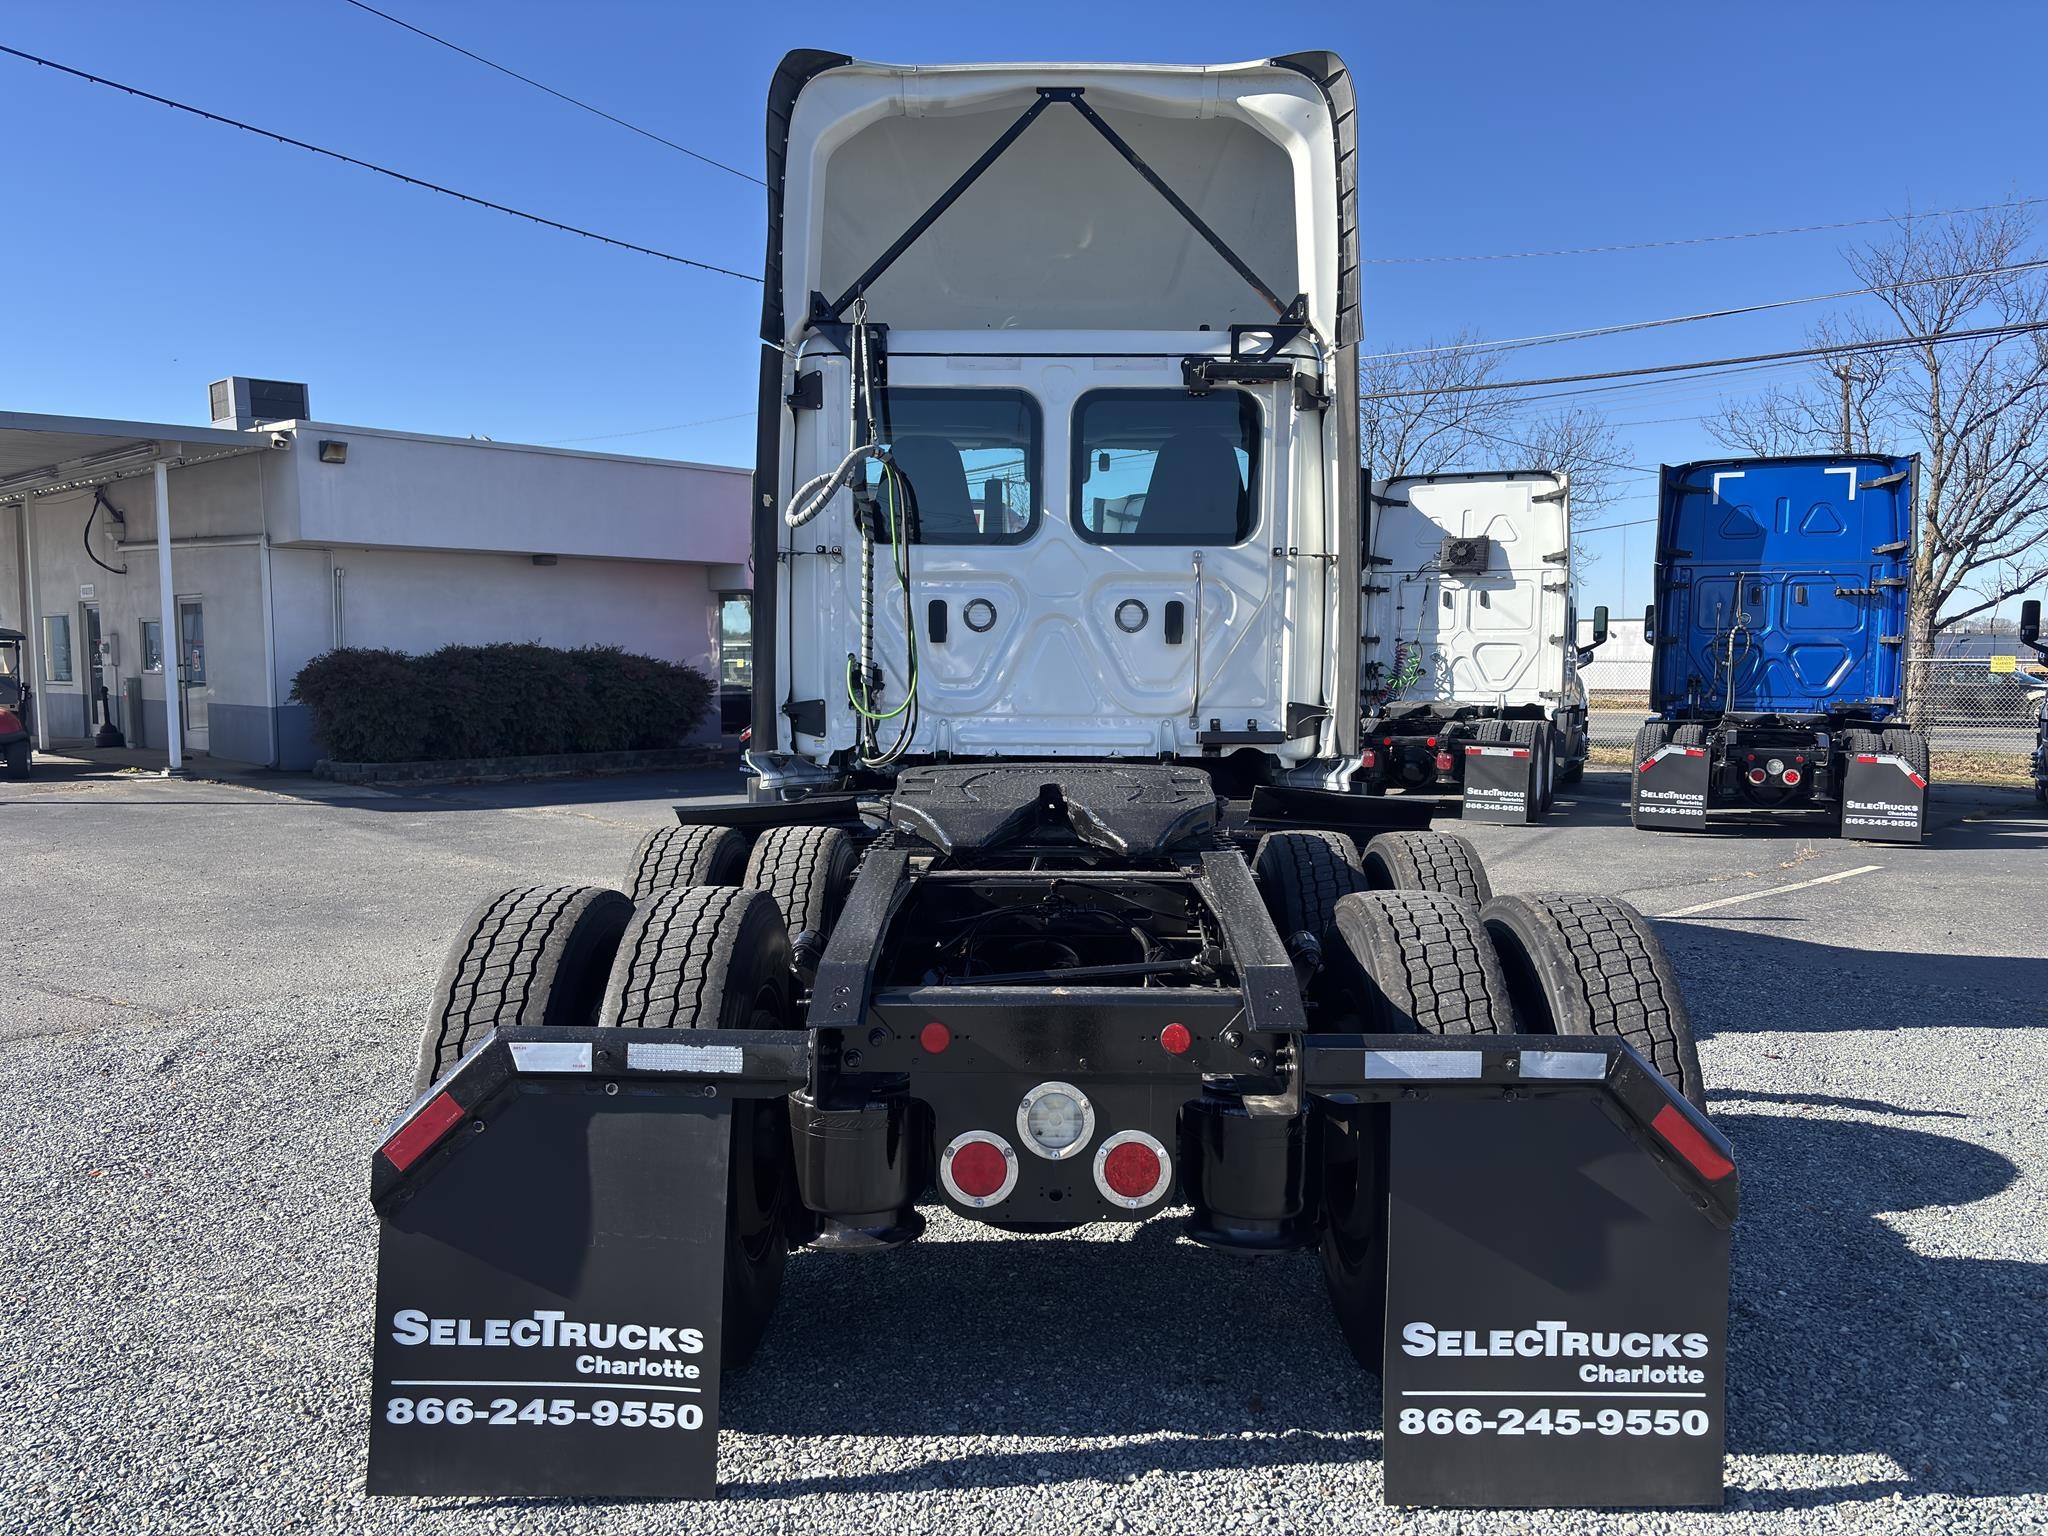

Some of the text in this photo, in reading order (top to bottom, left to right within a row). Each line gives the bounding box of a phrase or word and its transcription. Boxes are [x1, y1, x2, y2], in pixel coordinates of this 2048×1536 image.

[1845, 817, 1918, 827] 866-245-9550
[392, 1309, 704, 1354] SELECTRUCKS
[1401, 1320, 1709, 1358] SELECTRUCKS
[575, 1354, 701, 1379] Charlotte
[1578, 1363, 1705, 1384] Charlotte
[386, 1397, 704, 1431] 866-245-9550
[1398, 1407, 1710, 1437] 866-245-9550
